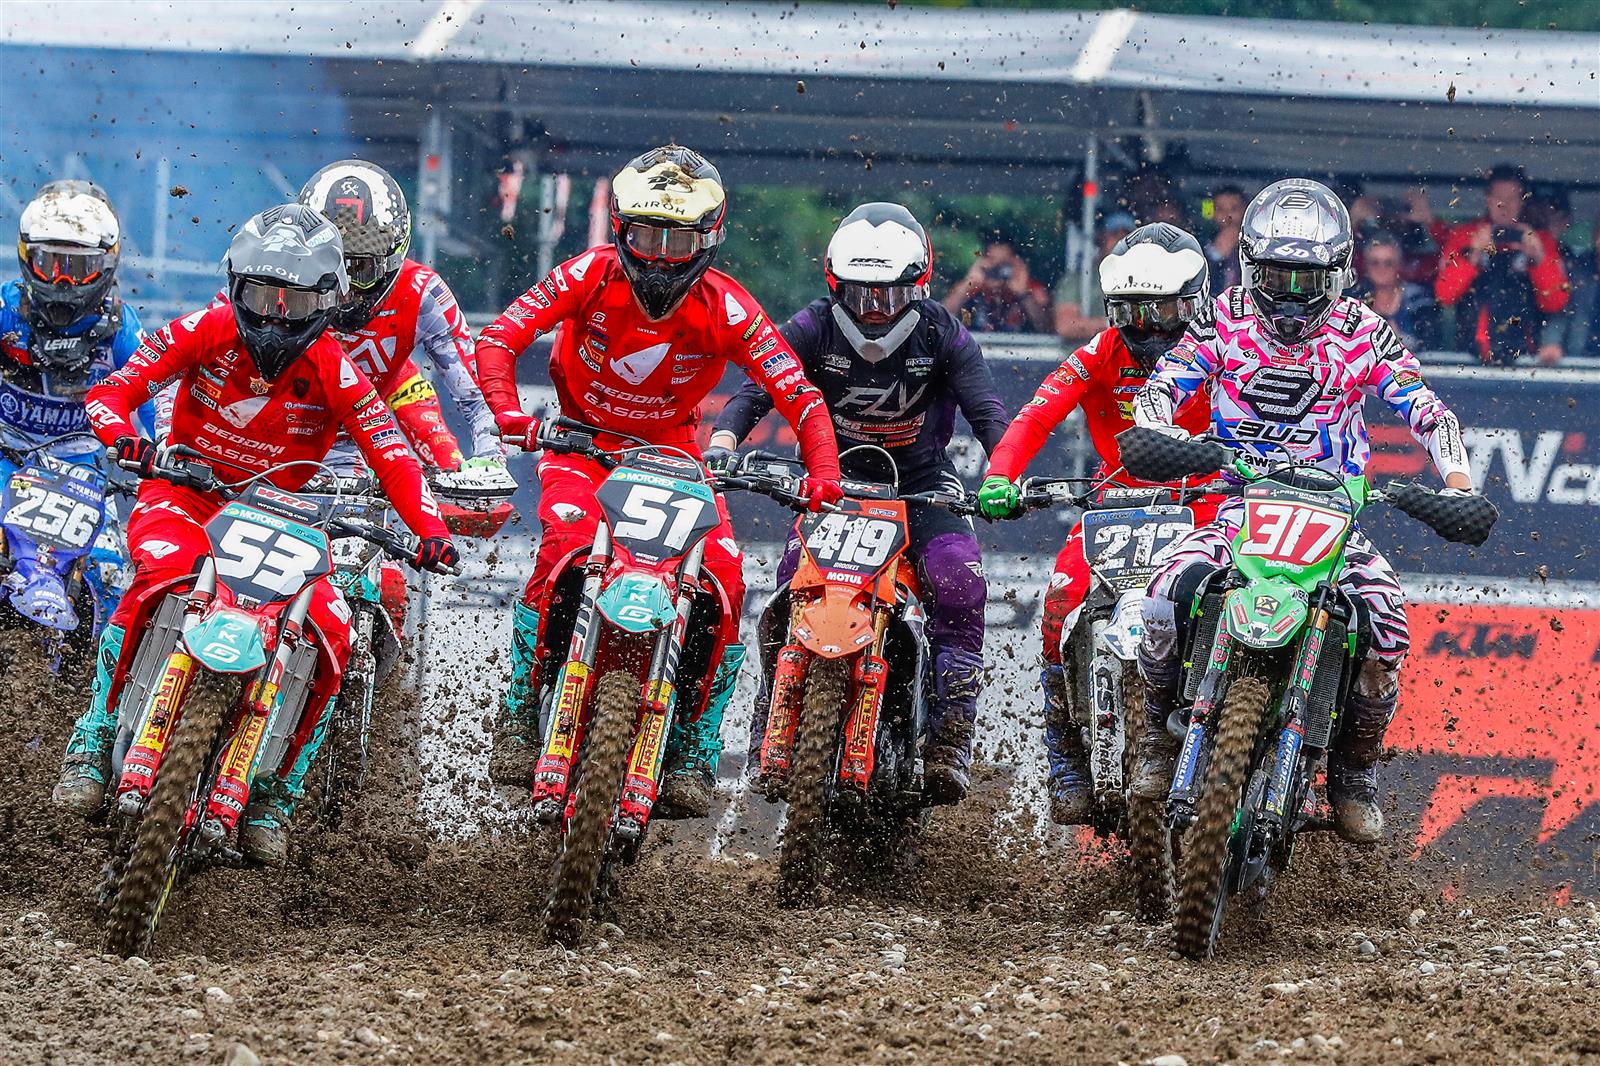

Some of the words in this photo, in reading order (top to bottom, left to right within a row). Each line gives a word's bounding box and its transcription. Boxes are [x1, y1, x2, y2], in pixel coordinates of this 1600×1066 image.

[631, 200, 685, 215] AIROH
[1274, 242, 1309, 258] 6D
[242, 263, 300, 282] AIROH
[1112, 280, 1163, 291] AIROH
[44, 337, 81, 351] LEATT
[20, 401, 88, 426] YAMAH
[584, 391, 677, 420] GASGAS
[639, 454, 696, 468] WRP
[641, 464, 691, 477] wrpracing.com
[627, 473, 676, 488] MOTOREX
[257, 488, 318, 510] WRP
[1280, 489, 1329, 502] PASTORELLO
[3, 487, 100, 547] 256
[240, 510, 289, 530] MOTOREX
[258, 502, 308, 521] wrpracing.com
[613, 485, 705, 550] 51
[806, 513, 898, 566] 419
[1239, 505, 1346, 563] 317
[215, 520, 321, 595] 53
[1094, 523, 1194, 570] 212
[833, 562, 859, 571] BROOKES
[826, 572, 863, 584] MOTUL
[1425, 622, 1538, 660] KTM
[254, 704, 280, 765] MOTOREX
[227, 717, 266, 777] PIRELLI
[635, 717, 663, 776] PIRELLI
[1177, 733, 1197, 788] MICHELIN
